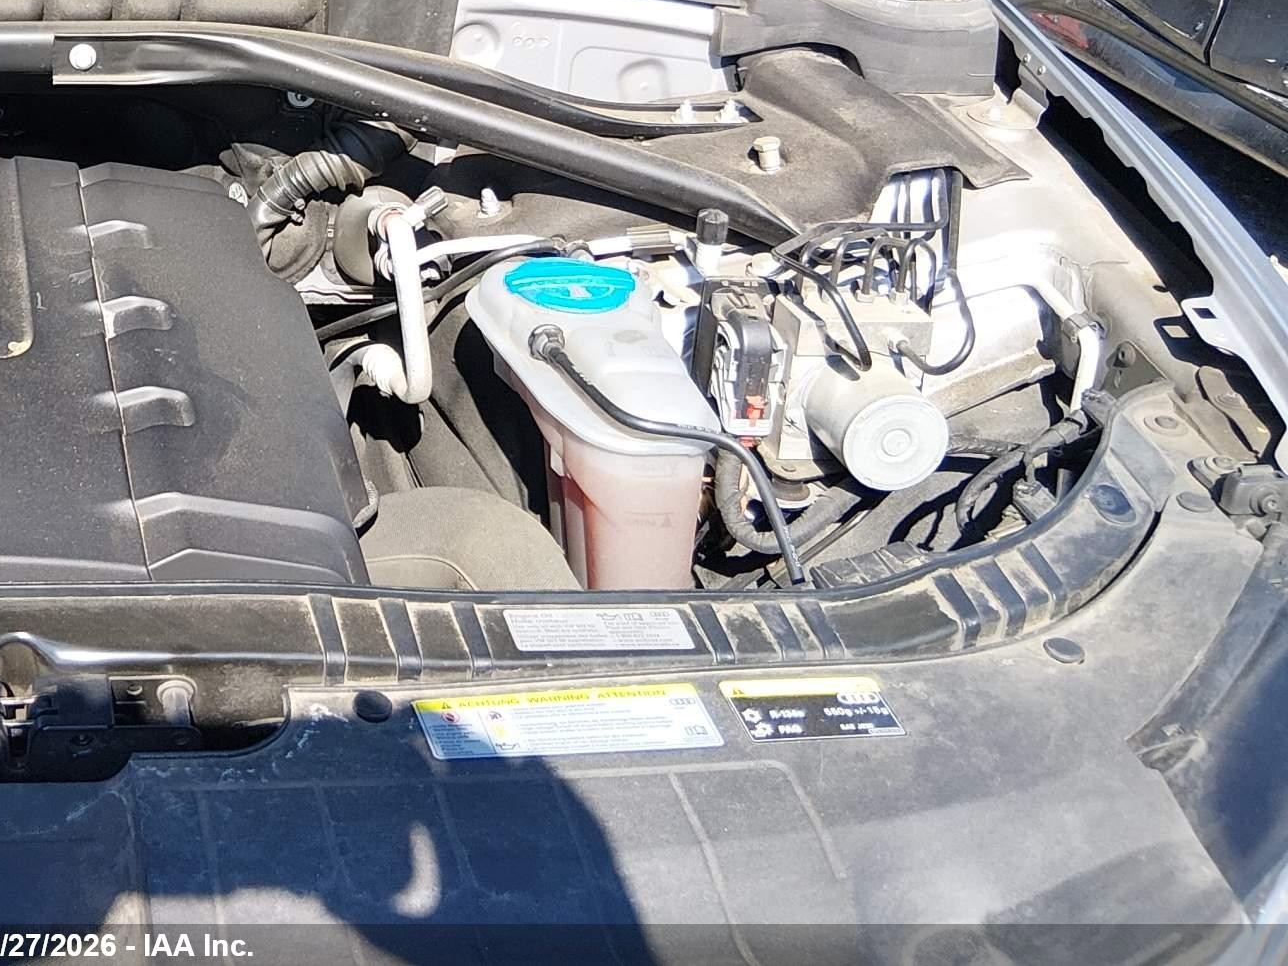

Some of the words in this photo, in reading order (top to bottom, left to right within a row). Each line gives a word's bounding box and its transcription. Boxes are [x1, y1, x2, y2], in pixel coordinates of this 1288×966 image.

[458, 698, 520, 708] ACHTUNG
[526, 694, 590, 703] WARNING
[597, 689, 666, 699] ATTENTION
